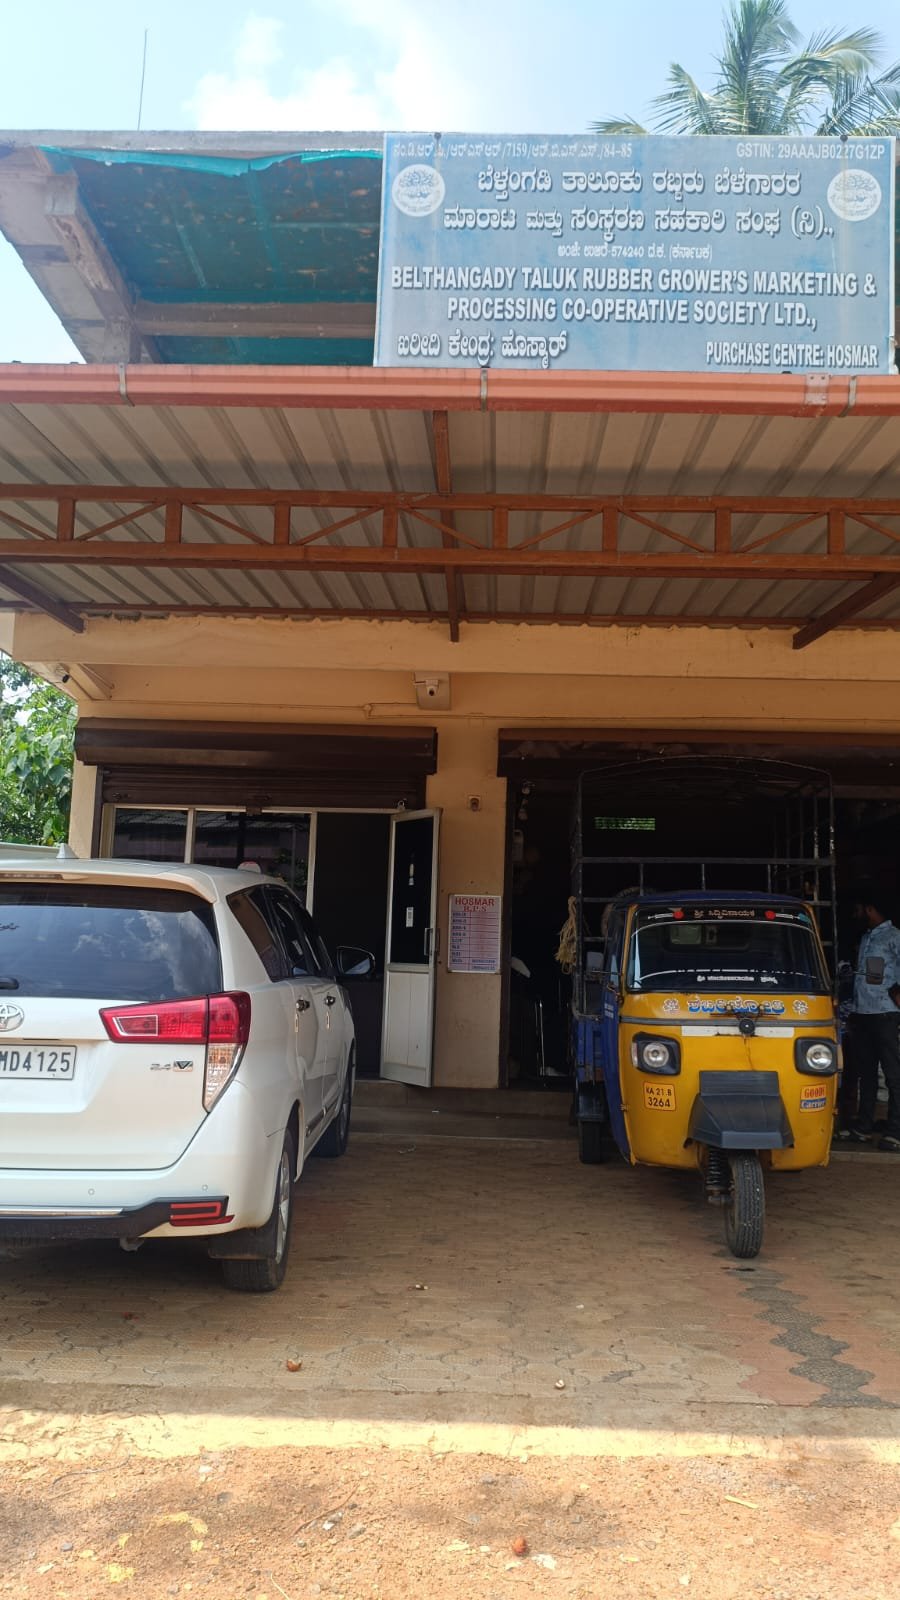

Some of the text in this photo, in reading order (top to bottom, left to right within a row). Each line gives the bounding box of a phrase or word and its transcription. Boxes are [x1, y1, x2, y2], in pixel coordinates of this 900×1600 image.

[736, 142, 775, 159] GSTIN:
[478, 164, 801, 200] ಬೆಳ್ತಂಗಡಿ ತಾಲೂಕು ರಬ್ಬರು ಬೆಳೆಗಾರರ
[443, 203, 517, 230] ಮಾರಾಟ
[526, 207, 563, 236] ಮತ್ತು
[654, 207, 726, 232] ಸಹಕಾರಿ
[735, 207, 781, 237] ಸಂಘ
[391, 266, 877, 296] BELTHANGADY TALUK RUBBER GROWER'S MARKETING &
[447, 297, 817, 331] PROCESSING CO-OPERATIVE SOCIETY LTD.,
[397, 333, 440, 357] ಖರೀದಿ
[706, 341, 878, 367] PURCHASE CENTRE: HOSMAR
[455, 898, 495, 906] HOSMAR
[0, 1051, 71, 1072] MD4125
[648, 1096, 671, 1107] 3264
